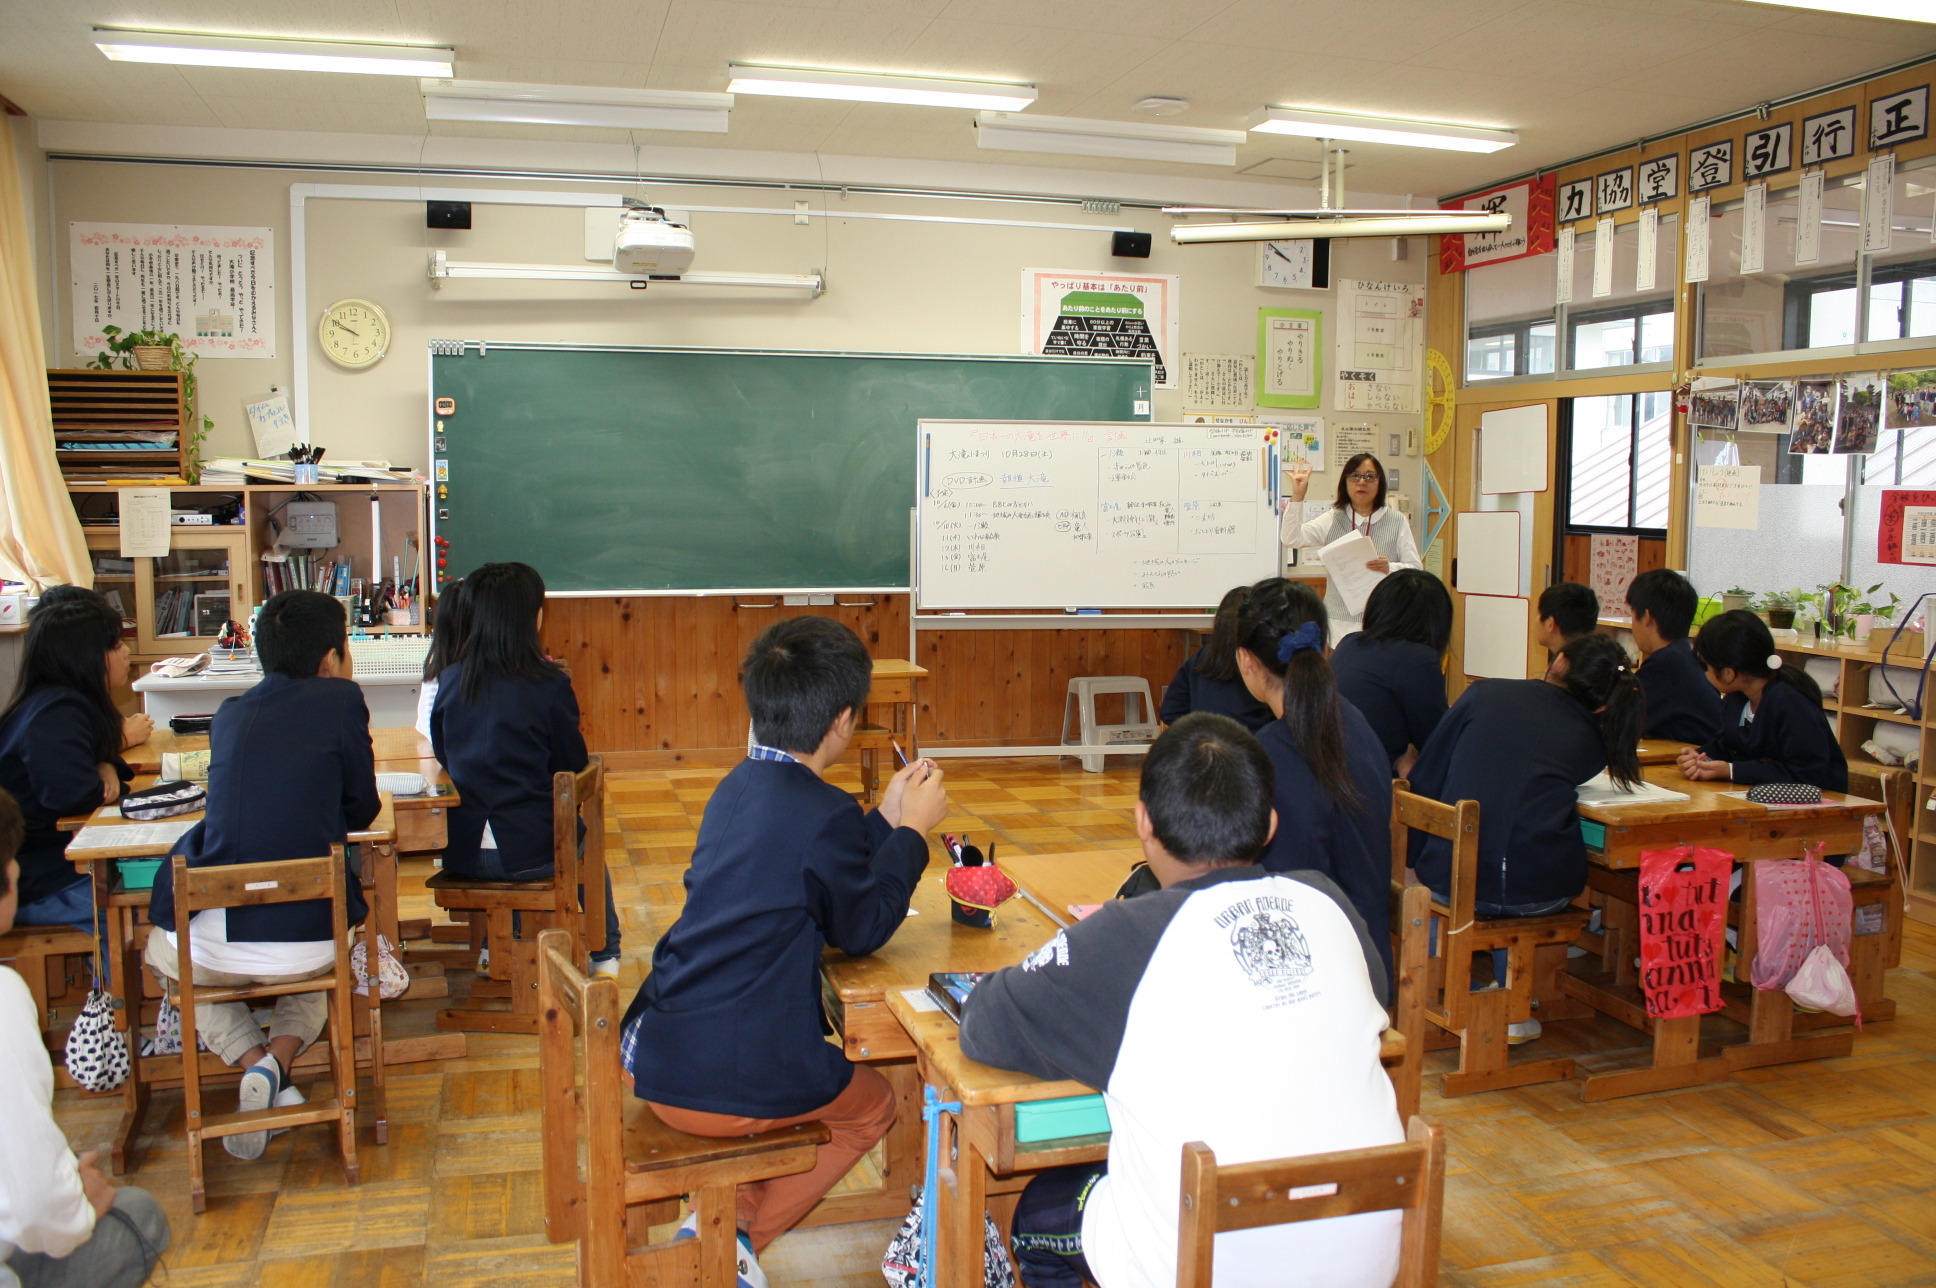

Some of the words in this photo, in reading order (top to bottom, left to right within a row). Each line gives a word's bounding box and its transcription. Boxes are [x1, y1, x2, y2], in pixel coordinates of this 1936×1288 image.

[1877, 98, 1921, 141] 正
[1751, 131, 1781, 173] 引
[1812, 119, 1846, 159] 行
[1647, 161, 1672, 201] 堂
[1697, 149, 1731, 187] 登
[1564, 185, 1585, 219] 力
[1601, 173, 1630, 205] 協
[1051, 281, 1148, 294] やっぱり基本は「あたり前」
[1357, 280, 1409, 292] ひなんけいろ
[1062, 304, 1143, 315] あたり前のことをあたり前にする
[1341, 371, 1375, 381] やくそく
[1137, 403, 1146, 413] 月
[1213, 898, 1256, 929] URBAN
